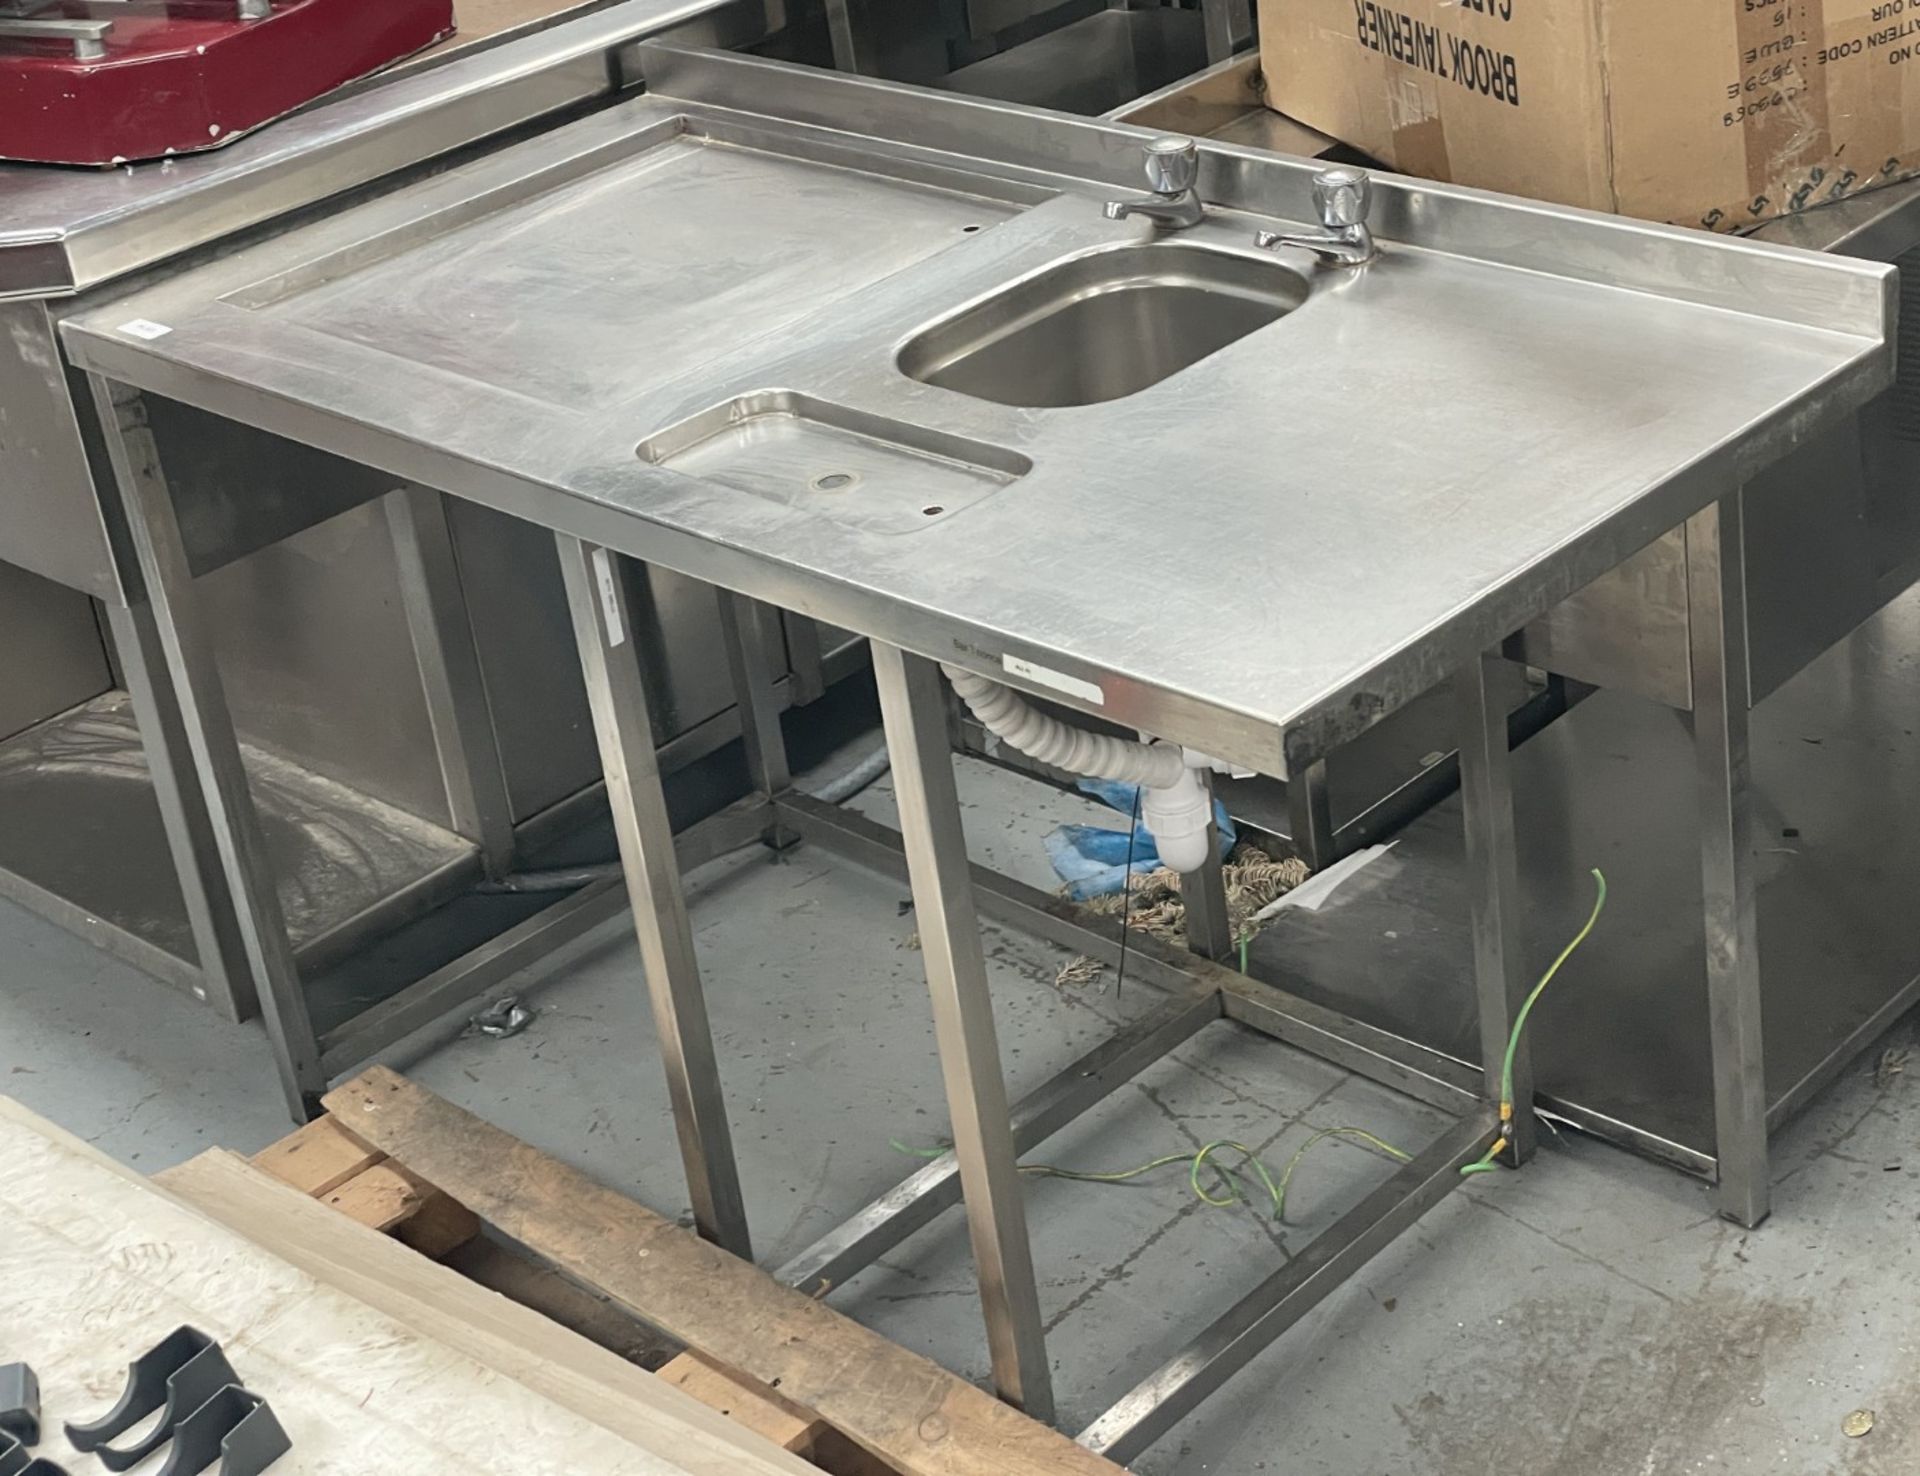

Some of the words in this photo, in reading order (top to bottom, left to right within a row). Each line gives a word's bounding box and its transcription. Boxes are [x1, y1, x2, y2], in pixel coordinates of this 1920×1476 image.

[1354, 0, 1448, 78] TAVERNER
[1817, 39, 1863, 65] CODE
[1888, 44, 1912, 65] NO
[1447, 32, 1519, 106] BROOK
